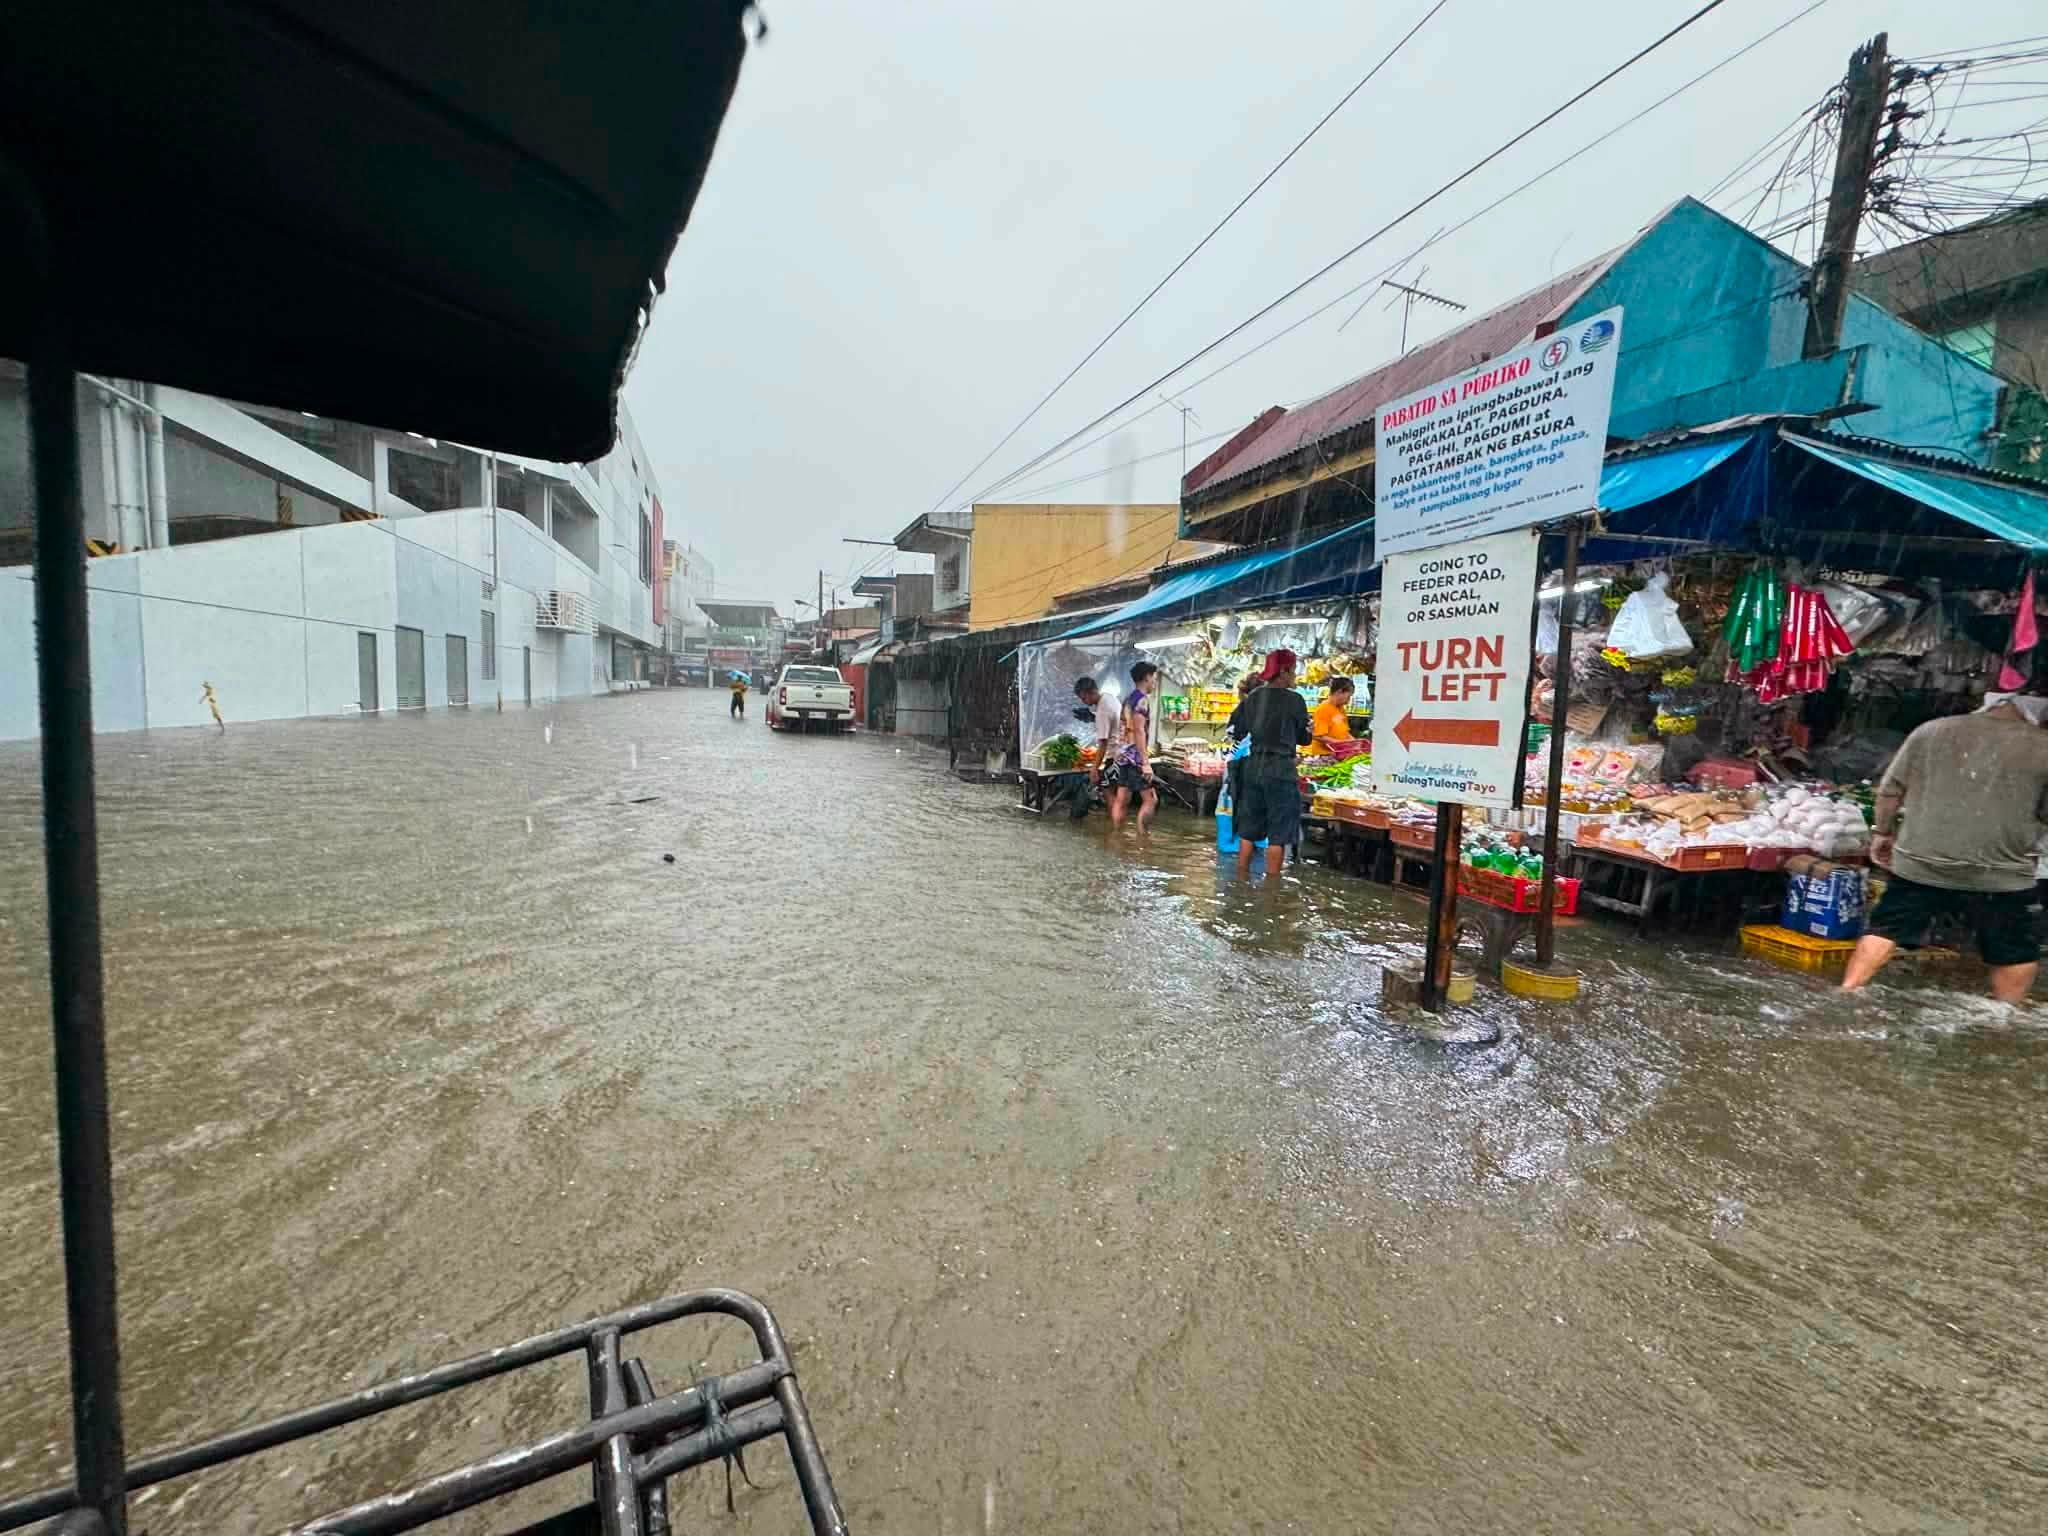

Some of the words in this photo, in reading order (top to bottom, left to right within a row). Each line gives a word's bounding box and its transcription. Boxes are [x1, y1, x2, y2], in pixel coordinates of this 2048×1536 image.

[1382, 395, 1437, 432] PABATID
[1440, 387, 1457, 409] SA
[1462, 357, 1531, 401] PUBLIKO
[1386, 421, 1436, 449] Mahigpit
[1438, 416, 1453, 428] na
[1456, 371, 1560, 422] ipinagbabawal
[1562, 361, 1595, 380] ang
[1398, 417, 1485, 456] PAGKAKALAT,
[1488, 386, 1569, 423] PAGDURA,
[1463, 414, 1531, 448] PAGDUMI
[1534, 408, 1552, 422] at
[1391, 447, 1482, 488] PAGTATAMBAK
[1486, 439, 1508, 455] NG
[1511, 416, 1575, 447] BASURA
[1550, 430, 1590, 450] plaza,
[1441, 478, 1467, 494] lahat
[1469, 475, 1483, 488] ng
[1485, 470, 1501, 482] iba
[1503, 460, 1534, 478] pang
[1536, 450, 1565, 465] mga
[1493, 477, 1523, 493] lugar
[1403, 575, 1455, 592] FEEDER
[1458, 568, 1505, 585] ROAD,
[1419, 557, 1464, 575] GOING
[1468, 553, 1488, 566] TO
[1407, 610, 1426, 623] OR
[1428, 602, 1500, 620] SASMUAN
[1421, 588, 1481, 605] BANCAL,
[1397, 635, 1504, 672] TURN
[1421, 672, 1507, 701] LEFT
